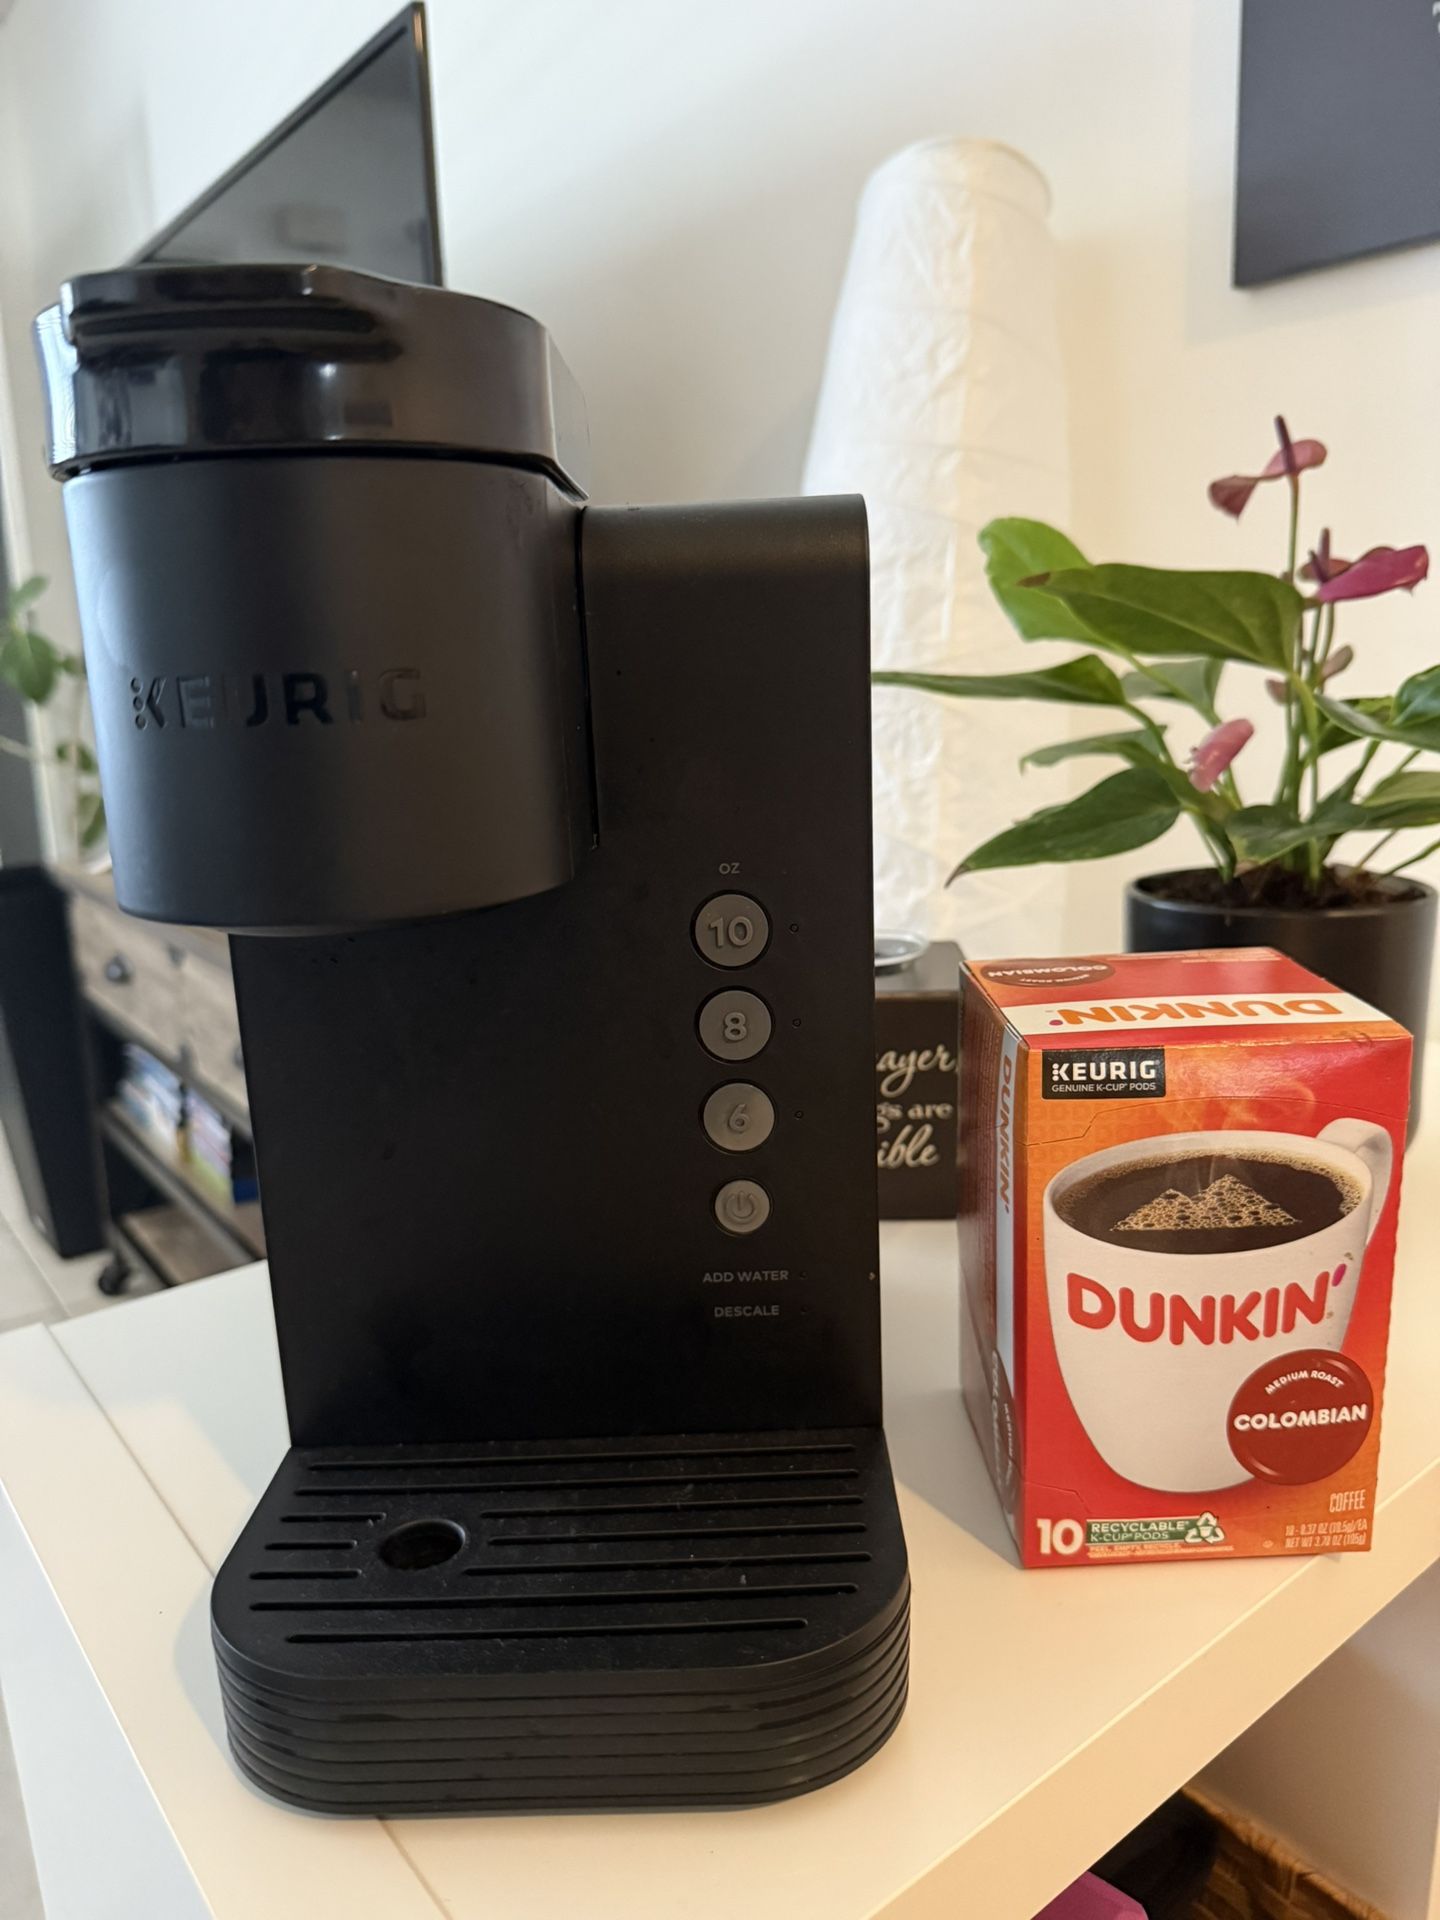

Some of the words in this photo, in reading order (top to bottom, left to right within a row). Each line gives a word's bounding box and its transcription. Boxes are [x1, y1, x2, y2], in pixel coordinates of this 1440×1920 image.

[130, 667, 427, 730] KEURIG
[719, 862, 740, 875] OZ
[708, 916, 753, 948] 10
[1050, 1000, 1342, 1026] DUNKIN'
[724, 1011, 748, 1042] 8
[1052, 1060, 1157, 1082] KEURIG
[1052, 1083, 1095, 1092] GENUINE
[1129, 1082, 1156, 1091] PODS
[728, 1103, 751, 1134] 6
[907, 1103, 953, 1120] are
[703, 1272, 734, 1283] ADD
[737, 1270, 789, 1282] WATER
[714, 1305, 780, 1317] DESCALE
[1067, 1263, 1347, 1345] DUNKIN'
[1264, 1370, 1309, 1395] MEDIUM
[1311, 1370, 1344, 1388] ROAST
[1233, 1403, 1368, 1432] COLOMBIAN
[1329, 1489, 1366, 1513] COFFEE
[1036, 1518, 1084, 1555] 10
[1134, 1532, 1169, 1540] PODS
